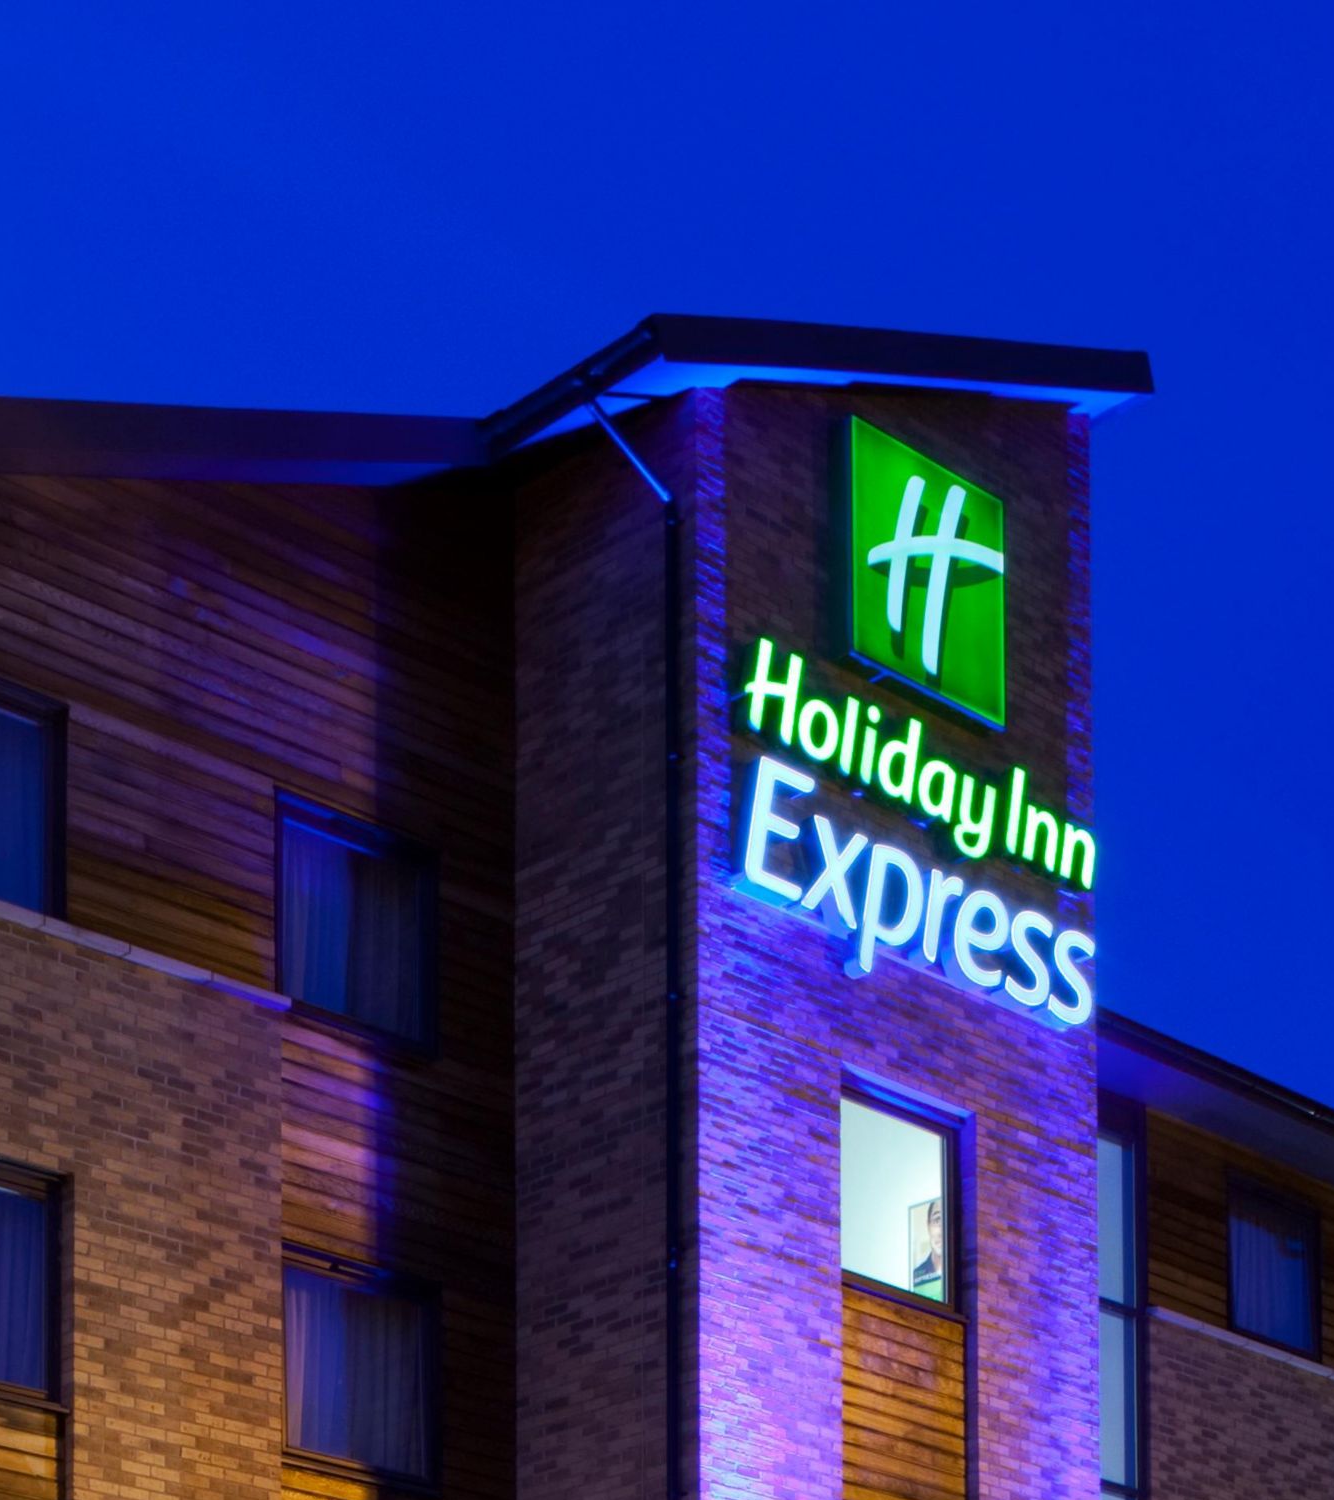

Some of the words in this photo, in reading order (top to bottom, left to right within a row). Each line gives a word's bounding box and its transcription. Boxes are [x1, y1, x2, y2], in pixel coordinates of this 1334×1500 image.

[744, 756, 1095, 1024] Express
[745, 637, 995, 858] Holiday
[1006, 767, 1095, 888] Inn
